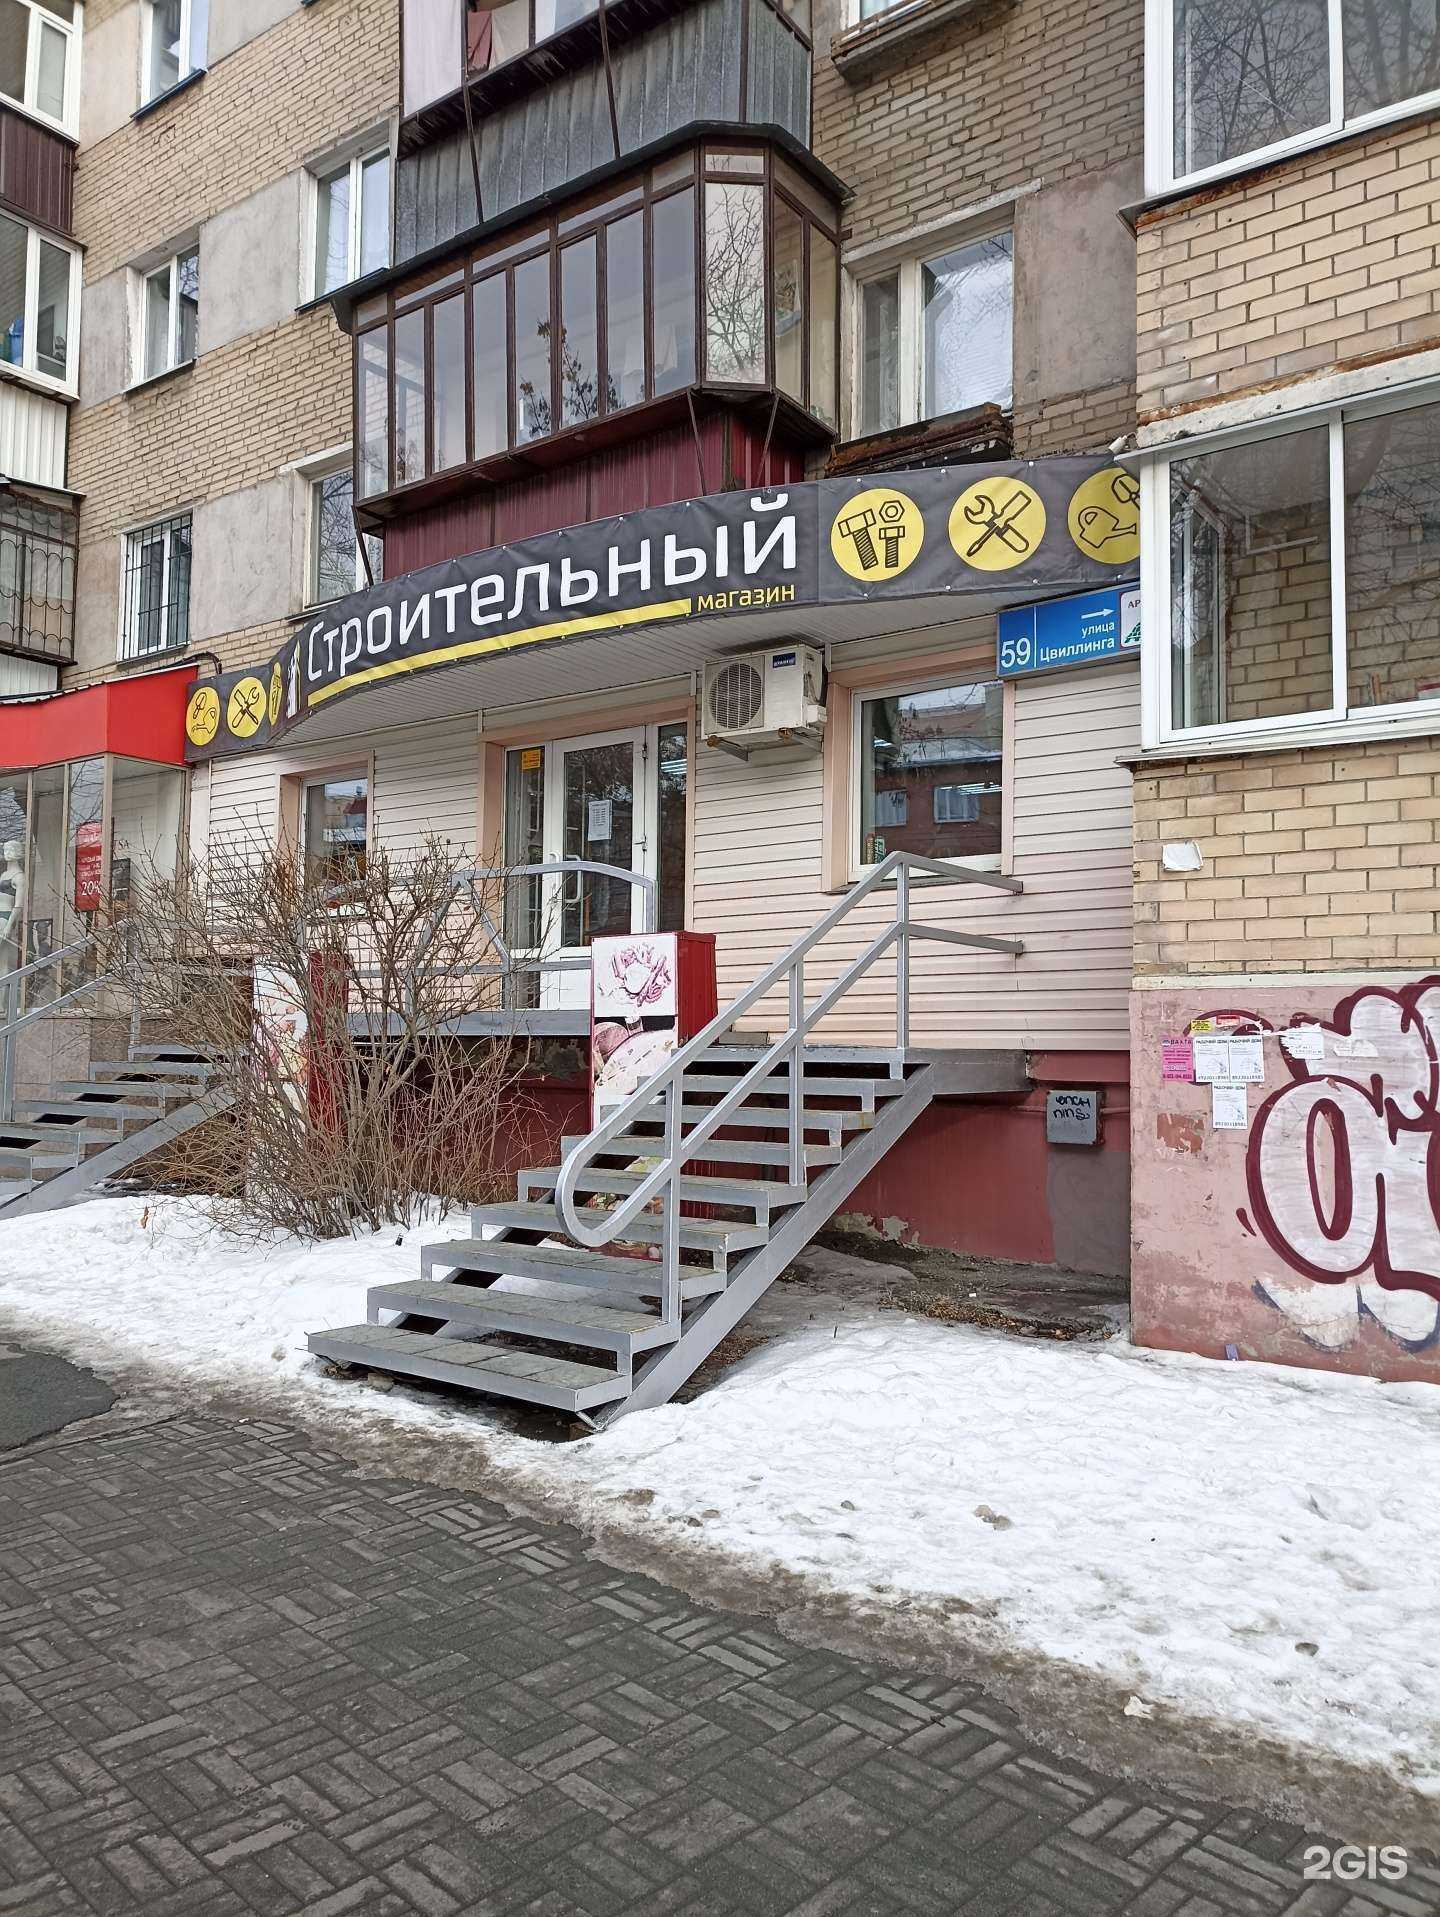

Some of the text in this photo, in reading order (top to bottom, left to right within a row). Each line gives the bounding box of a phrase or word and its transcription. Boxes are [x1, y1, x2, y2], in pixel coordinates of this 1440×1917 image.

[307, 493, 797, 682] Строительный
[697, 584, 796, 612] магазин
[1081, 622, 1115, 639] улица
[1000, 637, 1031, 668] 59
[1040, 637, 1115, 662] Цвиллинга
